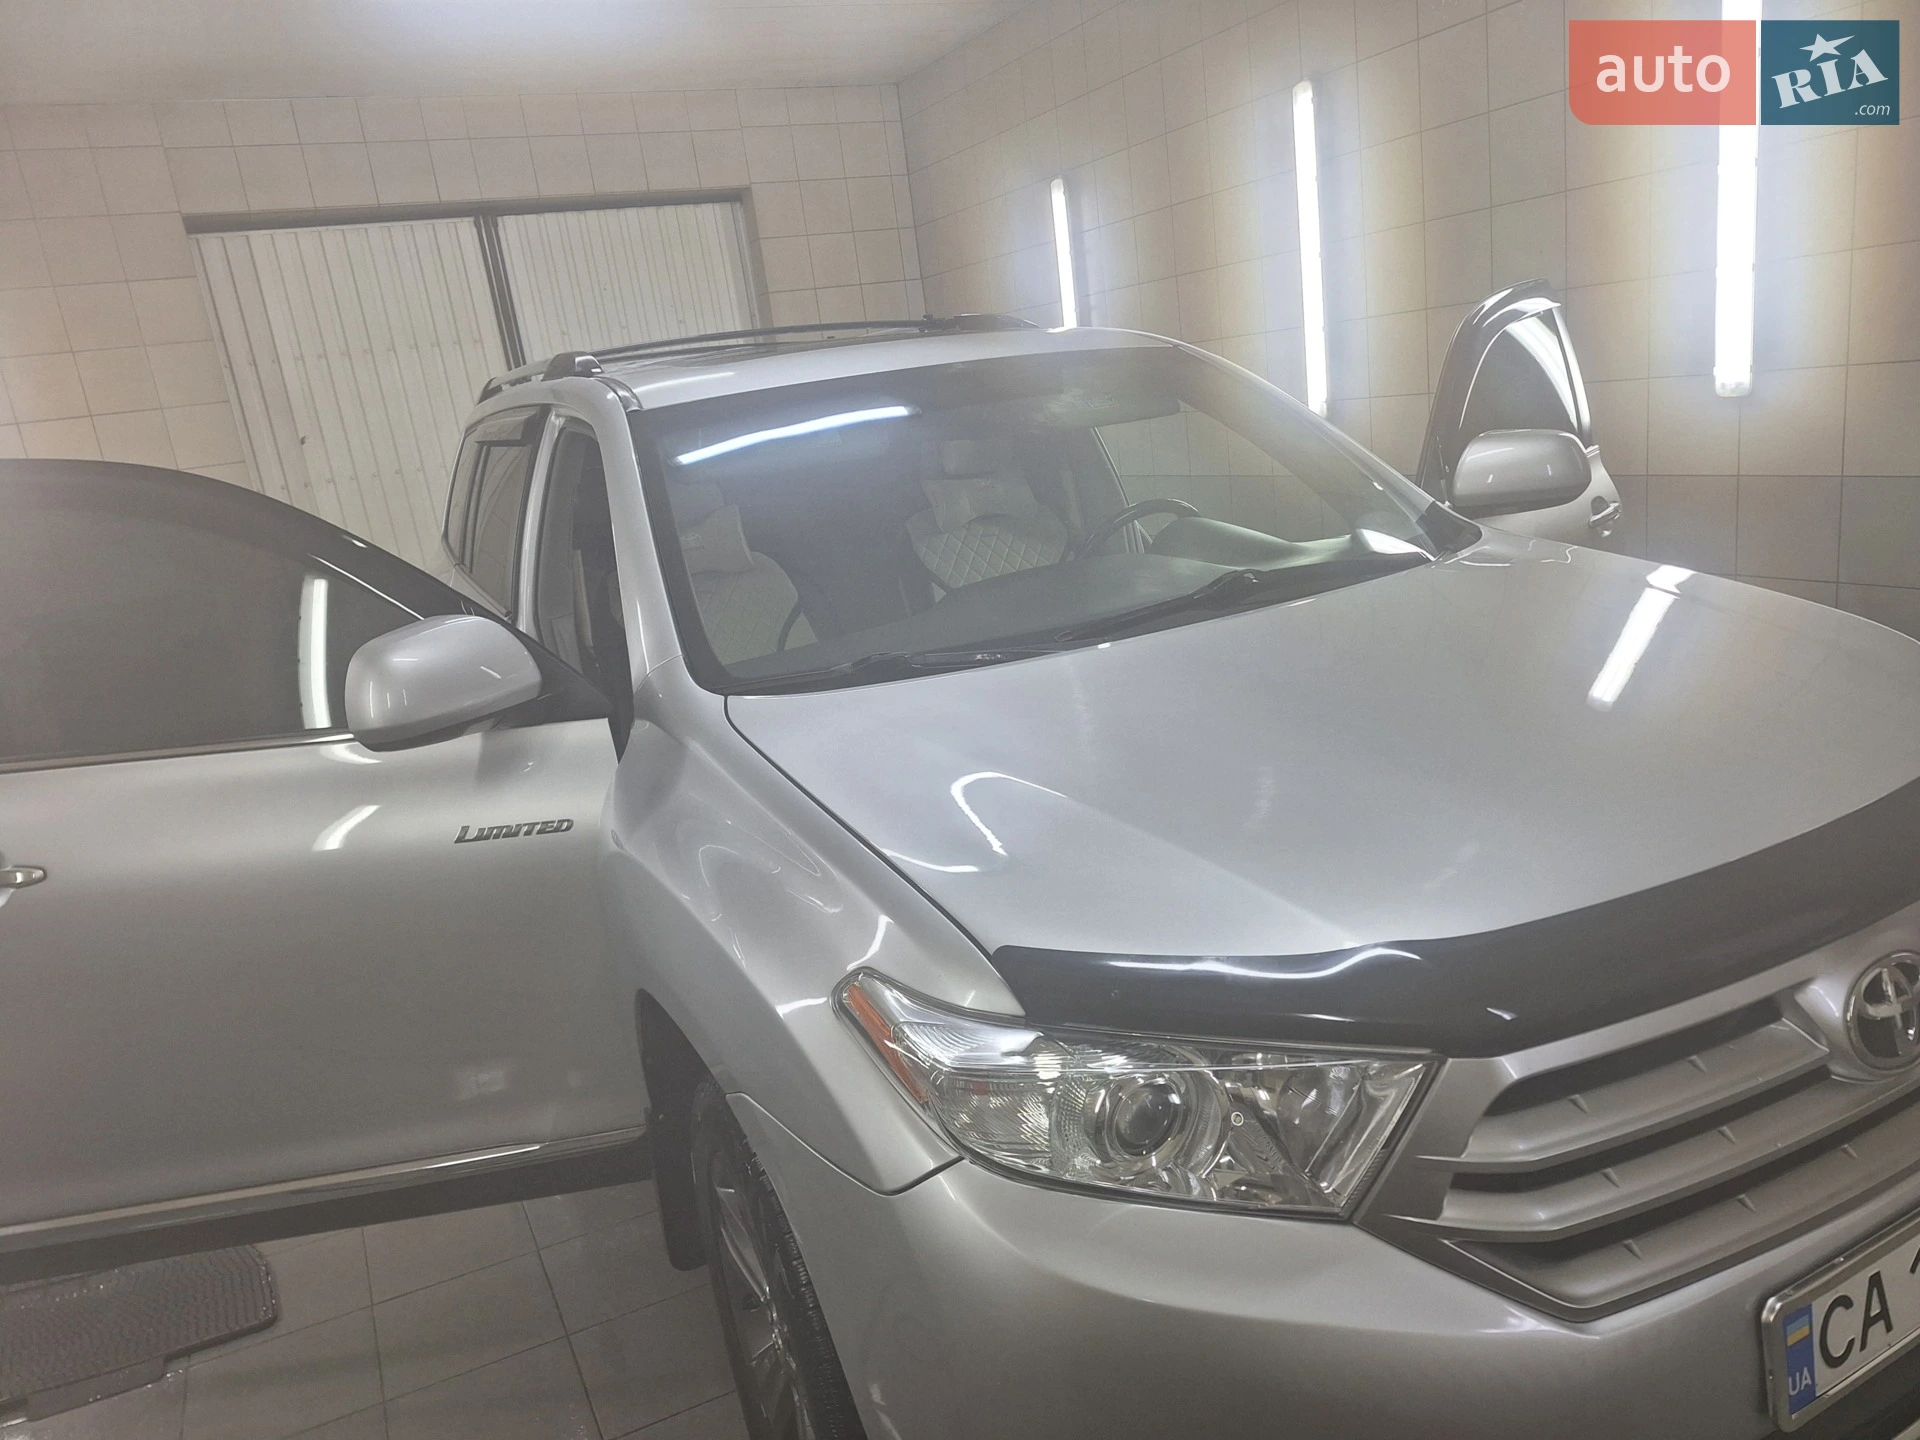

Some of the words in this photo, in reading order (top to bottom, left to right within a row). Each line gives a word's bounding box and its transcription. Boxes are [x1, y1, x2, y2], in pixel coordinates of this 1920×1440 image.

[454, 819, 574, 844] LIMITED
[1819, 1270, 1893, 1369] CA
[1788, 1367, 1813, 1395] UA
